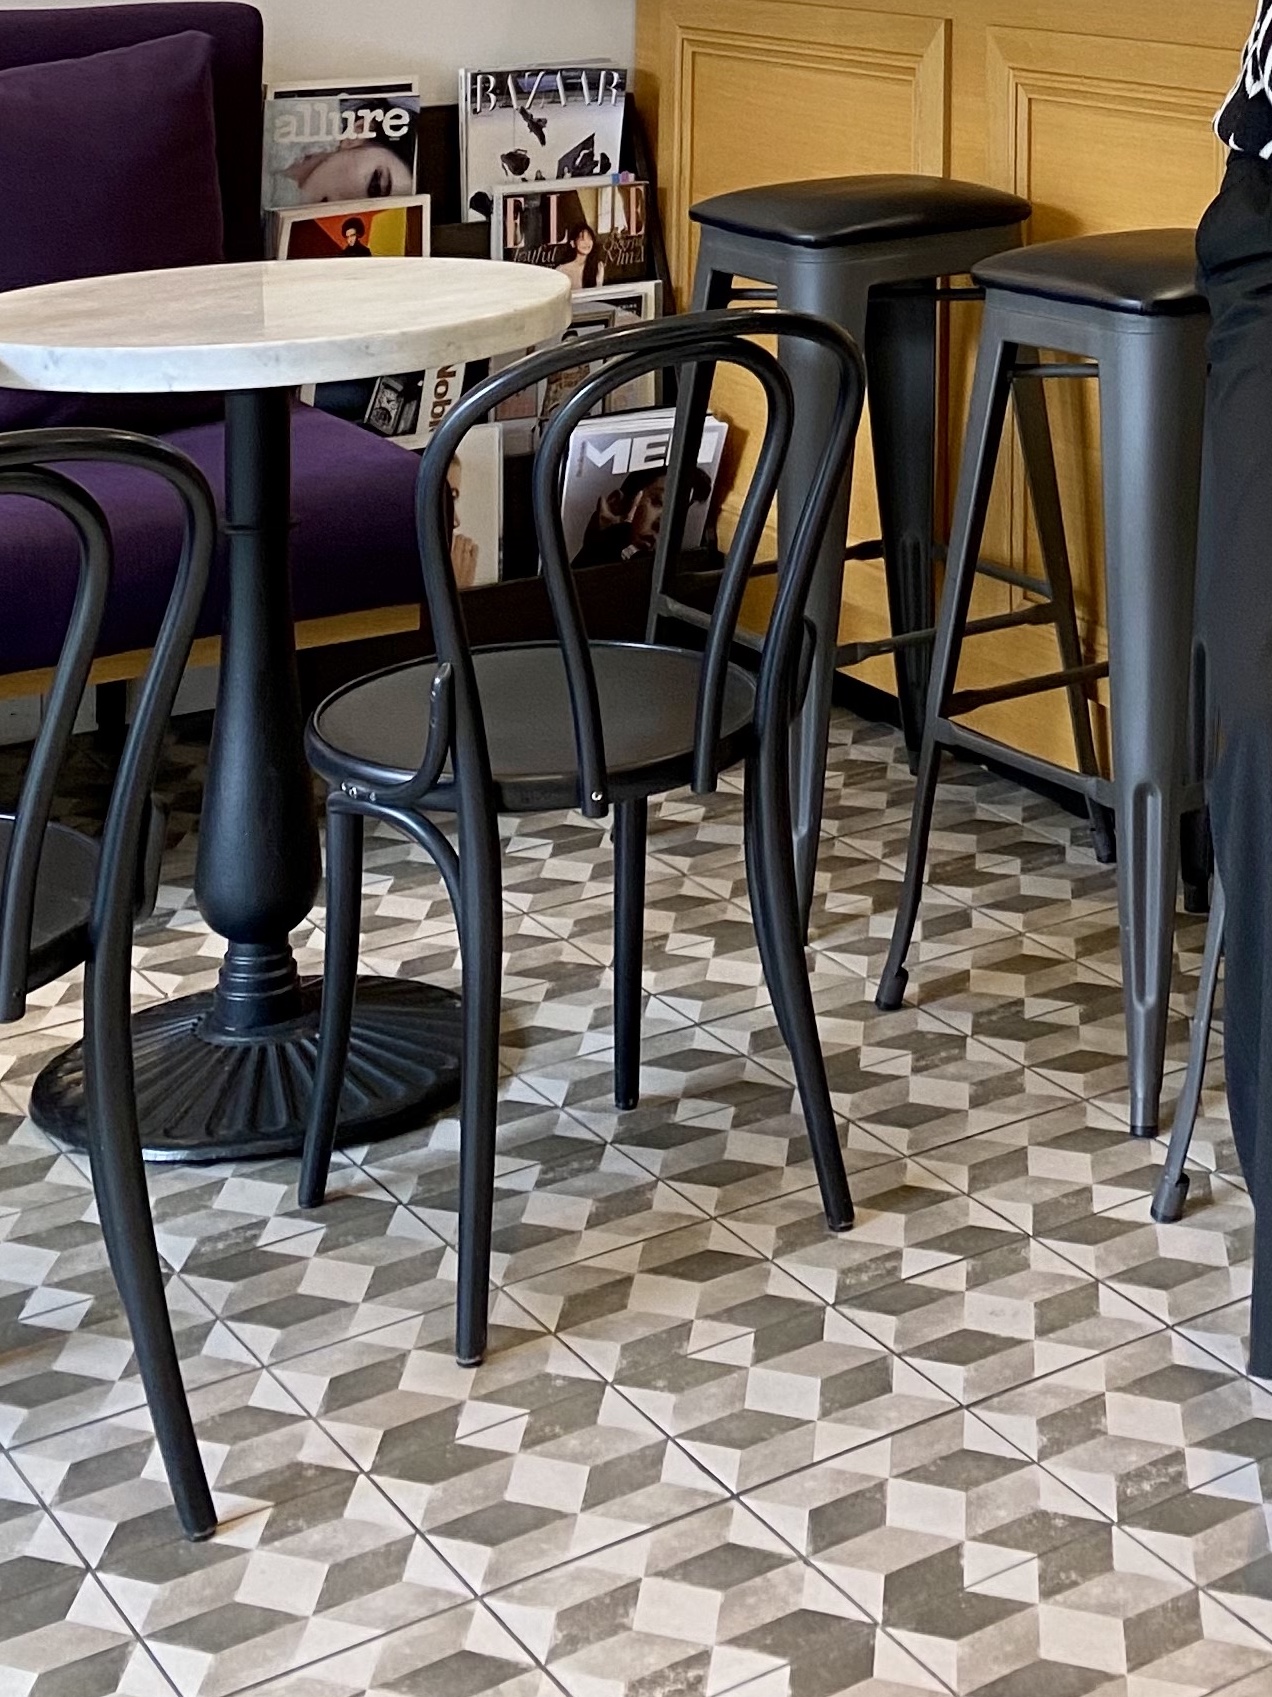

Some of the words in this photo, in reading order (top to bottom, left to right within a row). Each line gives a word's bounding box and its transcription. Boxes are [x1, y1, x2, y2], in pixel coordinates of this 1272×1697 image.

[474, 70, 621, 114] BAZAAR
[273, 103, 411, 143] allure
[504, 185, 646, 249] ELE
